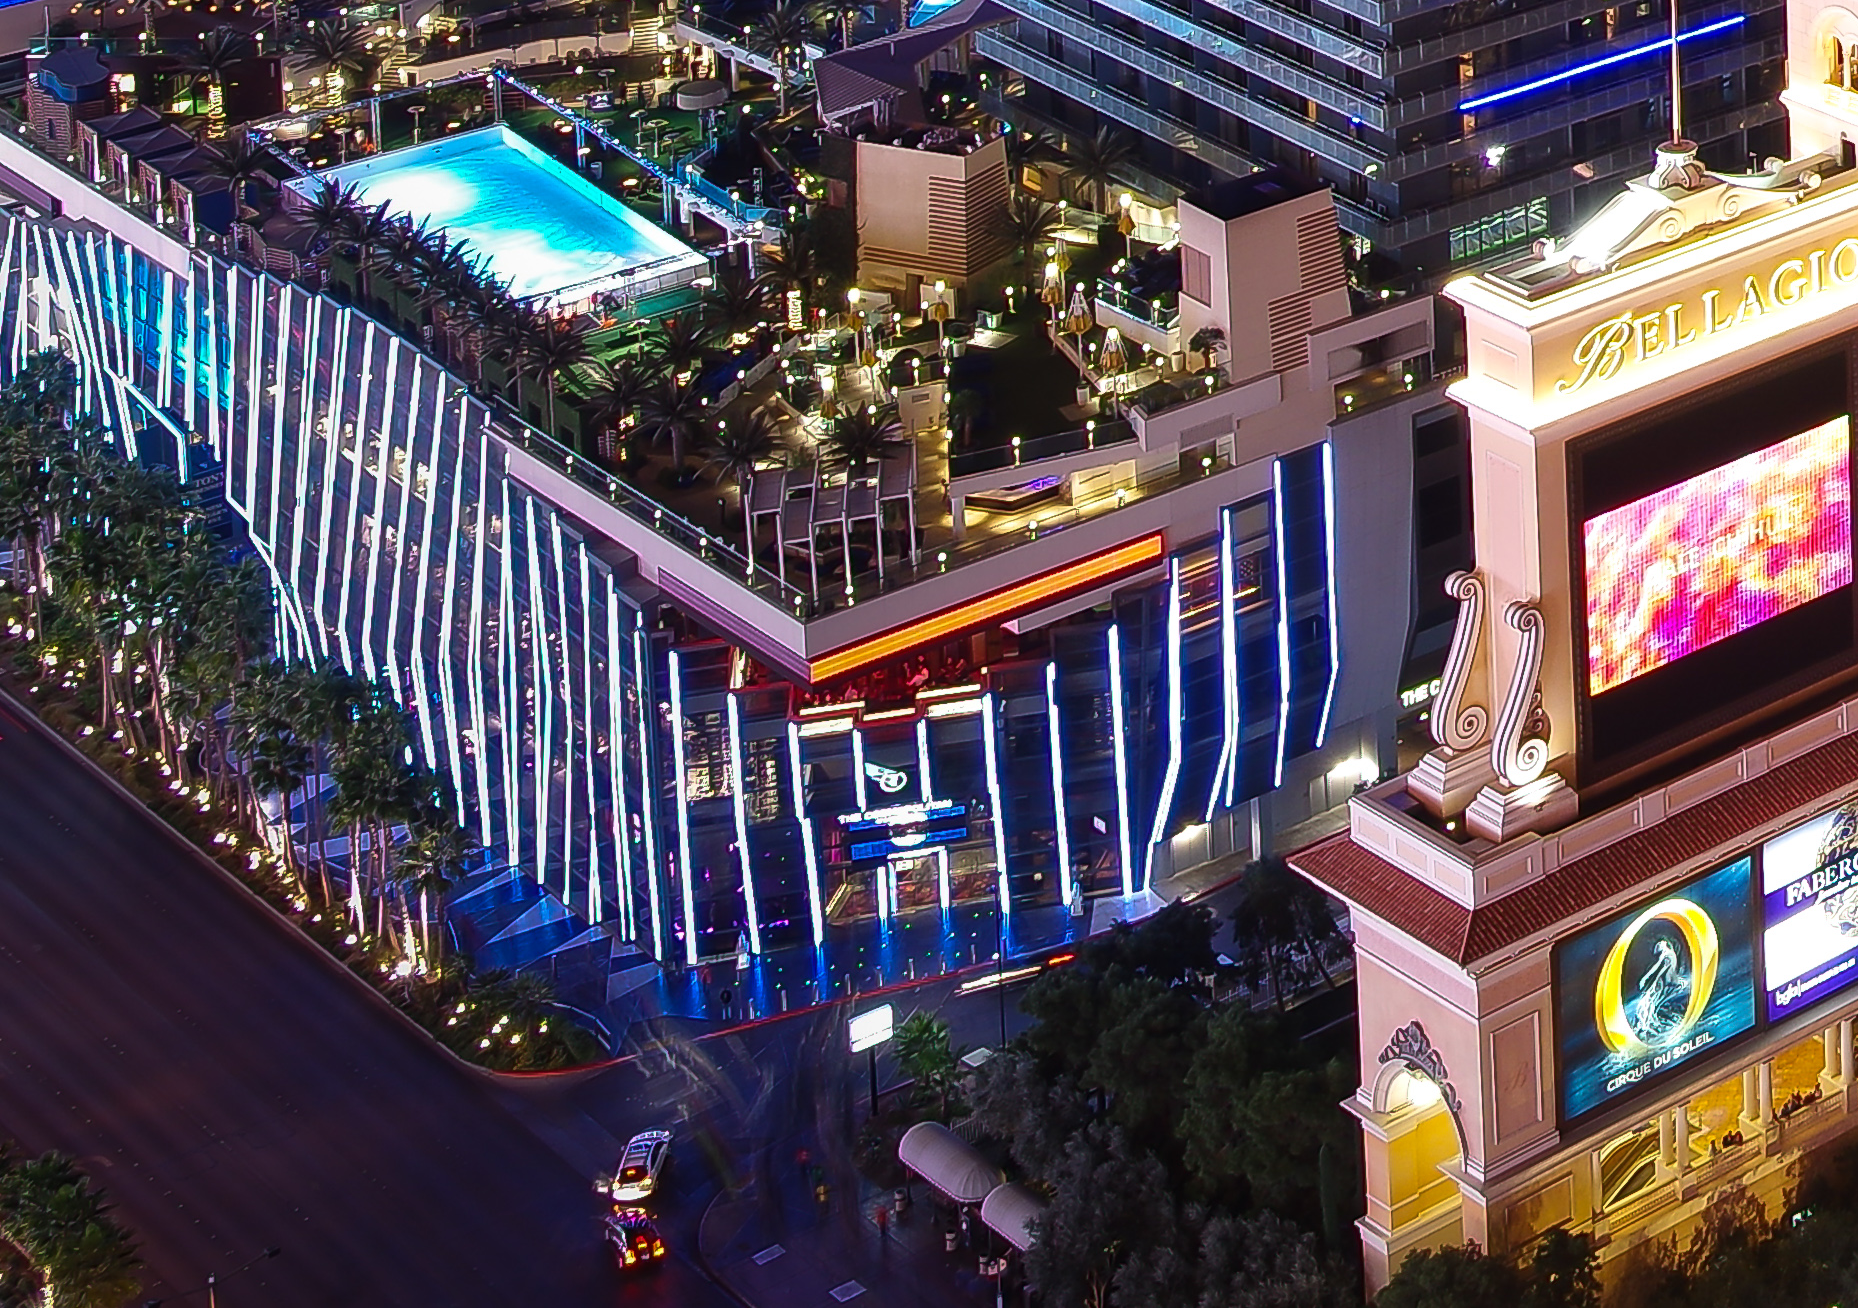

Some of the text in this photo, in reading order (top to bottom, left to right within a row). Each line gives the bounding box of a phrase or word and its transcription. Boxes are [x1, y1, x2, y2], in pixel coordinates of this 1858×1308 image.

[1401, 684, 1428, 708] THE
[1595, 899, 1720, 1058] O
[1606, 1032, 1715, 1092] CIRQUE DU SOLEIL
